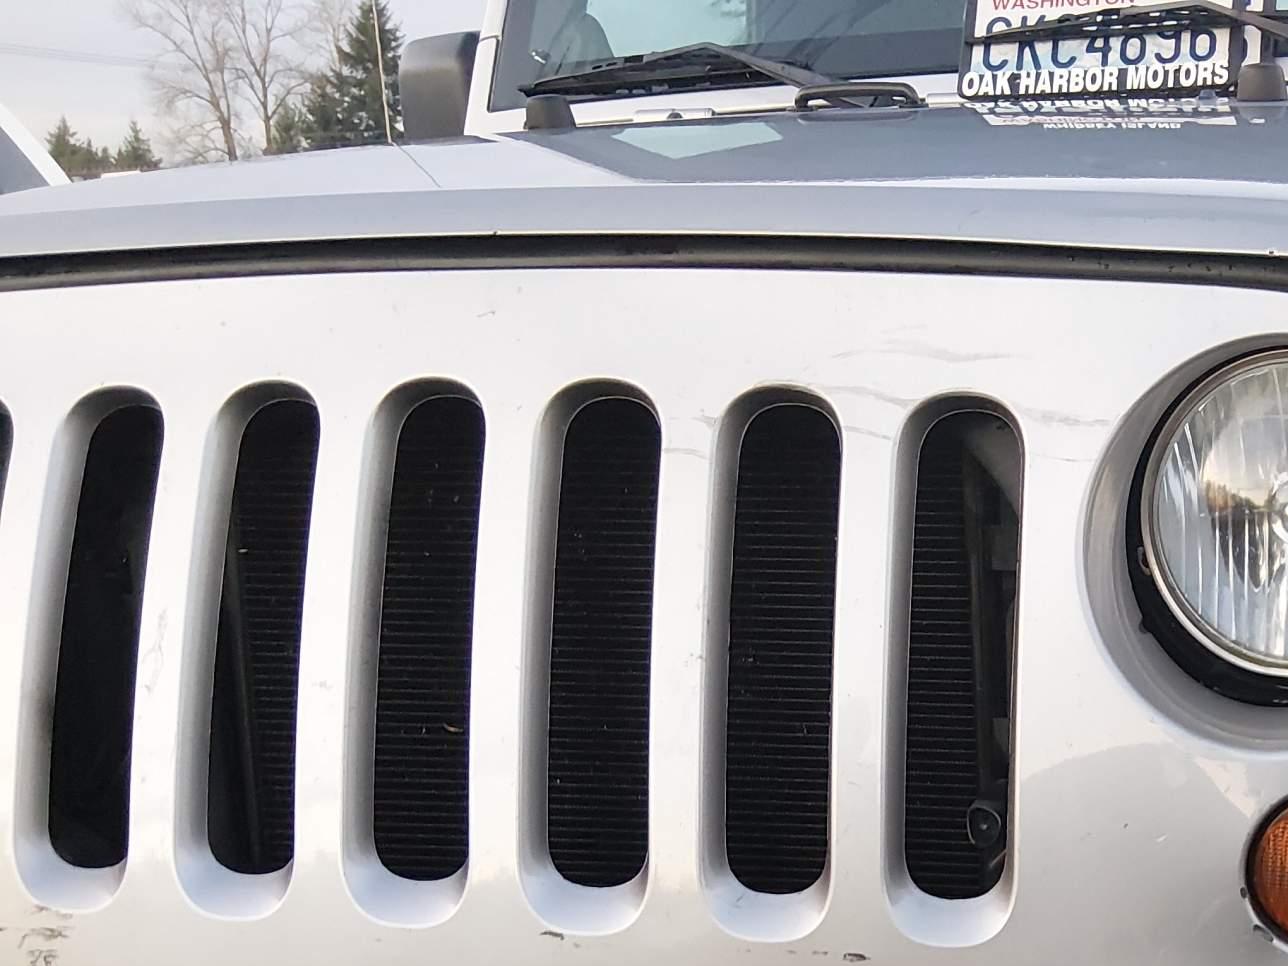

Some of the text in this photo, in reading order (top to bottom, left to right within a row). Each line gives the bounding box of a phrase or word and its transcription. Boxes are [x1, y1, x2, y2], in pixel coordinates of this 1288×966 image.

[993, 0, 1135, 10] WASHIN
[961, 62, 1229, 97] OAK HARBOR MOTORS
